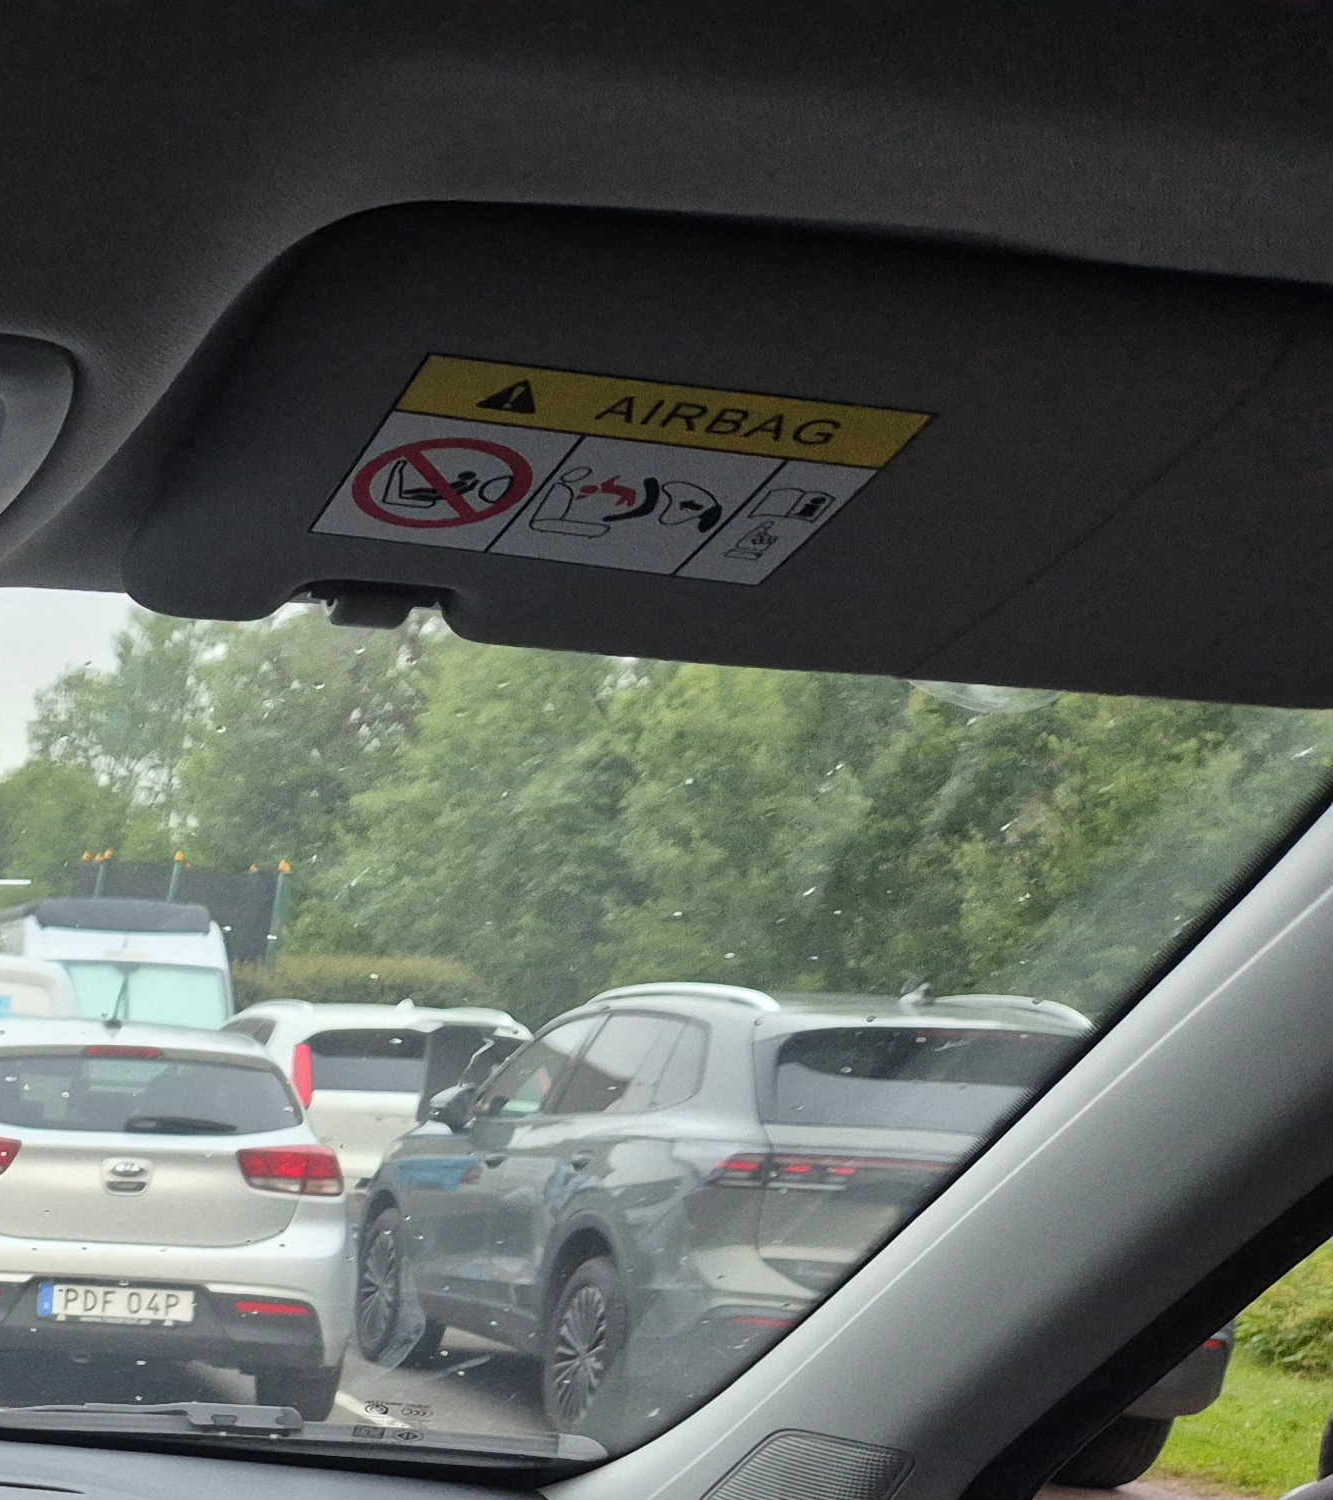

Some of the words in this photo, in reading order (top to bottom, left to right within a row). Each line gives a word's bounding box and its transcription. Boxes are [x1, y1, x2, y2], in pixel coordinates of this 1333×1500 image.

[594, 396, 841, 446] AIRBAG
[64, 1288, 116, 1313] PDF
[126, 1291, 180, 1317] 04P
